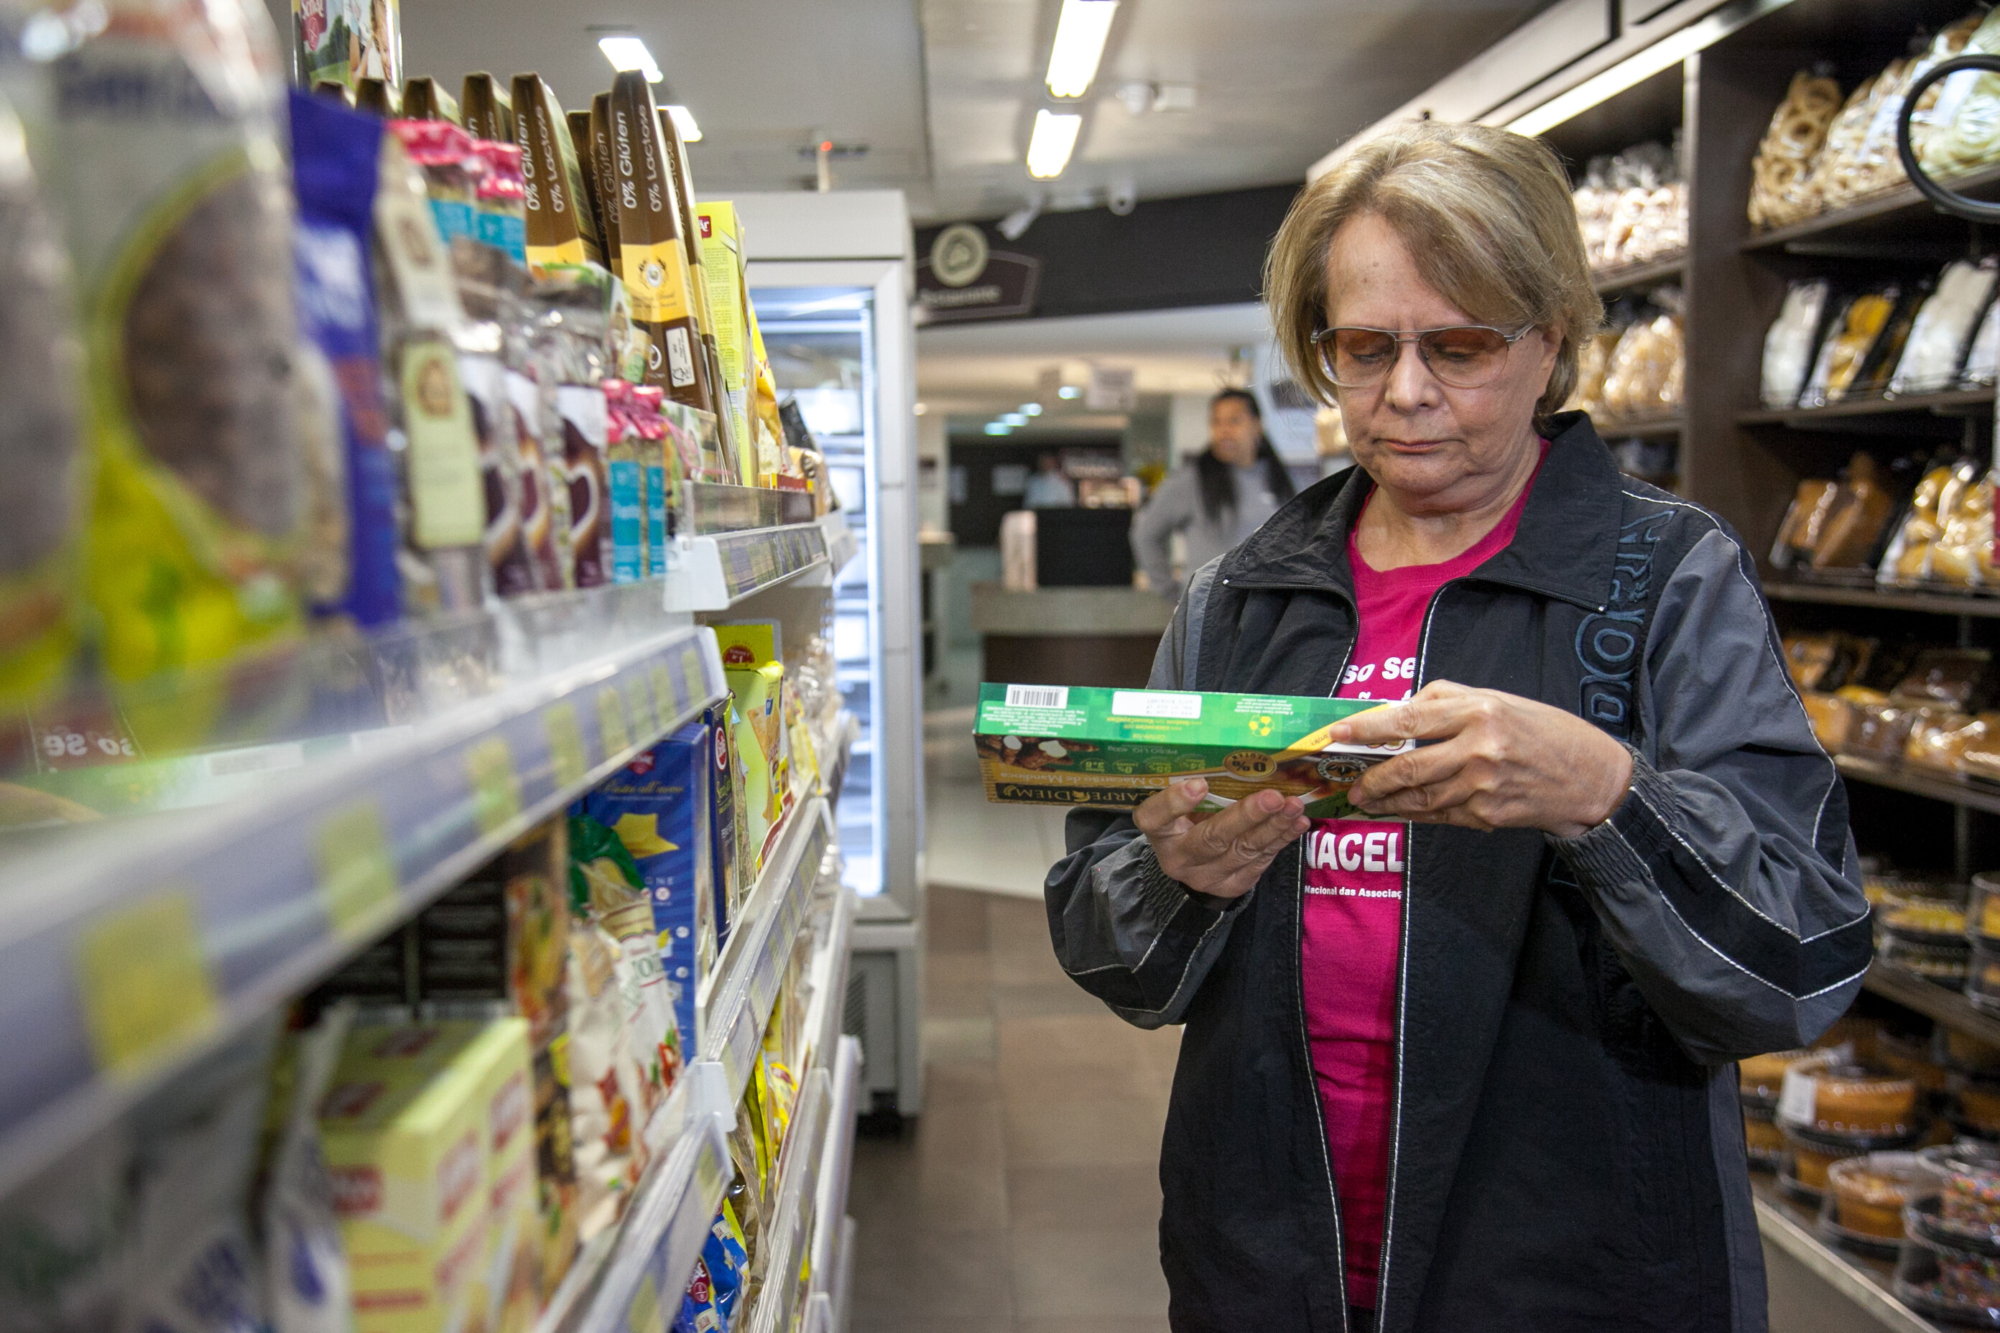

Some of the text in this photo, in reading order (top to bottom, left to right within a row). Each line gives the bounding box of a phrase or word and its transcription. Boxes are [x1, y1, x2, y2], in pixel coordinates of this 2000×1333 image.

[535, 105, 565, 213] 0% Lactose
[616, 110, 638, 209] 0% Glúten
[639, 104, 662, 212] 0% Lactose
[525, 182, 541, 211] 0%
[1231, 760, 1267, 773] 0%
[1000, 772, 1063, 784] Mandioca
[1015, 788, 1071, 801] DIEM
[1304, 885, 1337, 896] Nacional
[1339, 886, 1356, 896] das
